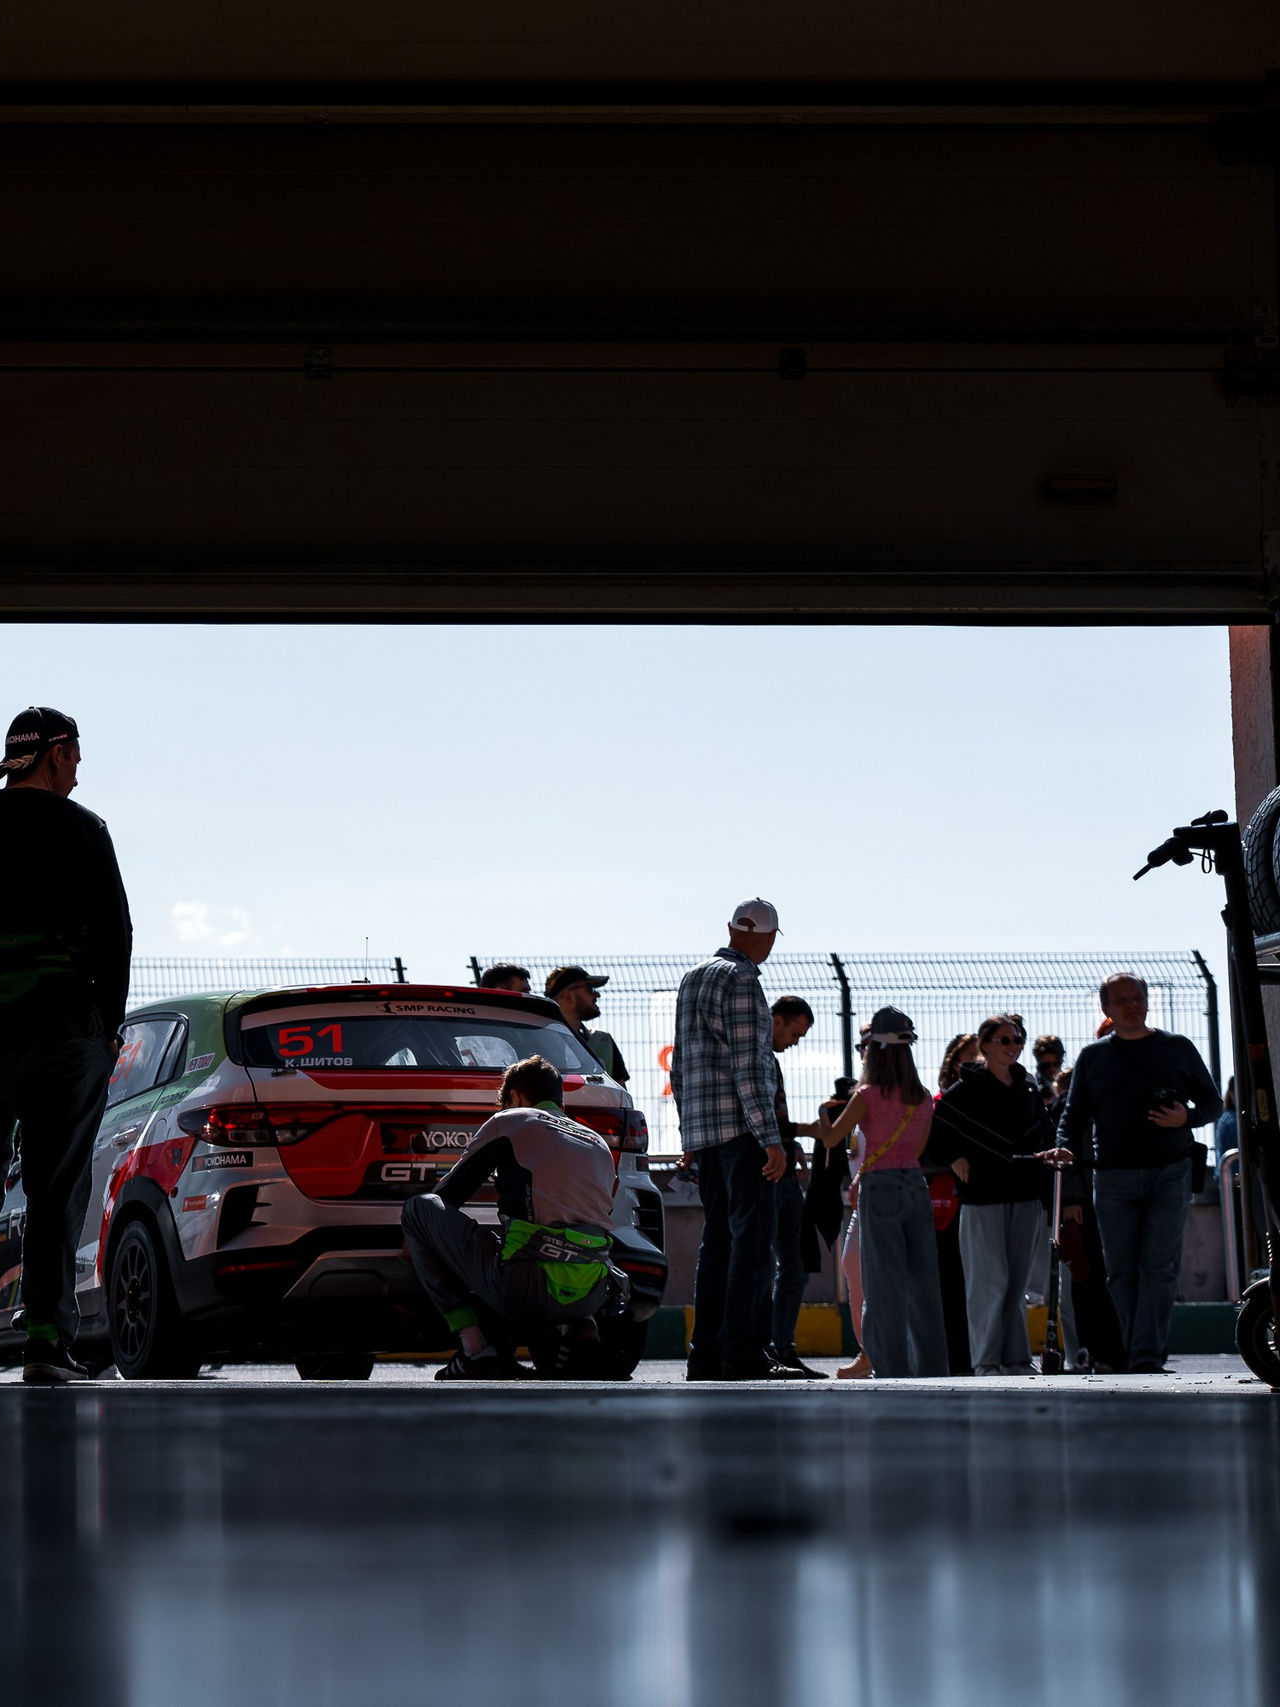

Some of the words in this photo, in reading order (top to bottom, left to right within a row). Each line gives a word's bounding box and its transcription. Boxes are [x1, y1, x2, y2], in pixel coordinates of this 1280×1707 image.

[396, 1004, 424, 1012] SMP
[427, 1005, 476, 1015] RACING
[278, 1023, 344, 1057] 51
[109, 1039, 144, 1085] 51
[284, 1057, 353, 1068] К.ШИТОВ
[422, 1130, 473, 1148] YOKO
[204, 1154, 247, 1167] YOKOHAMA
